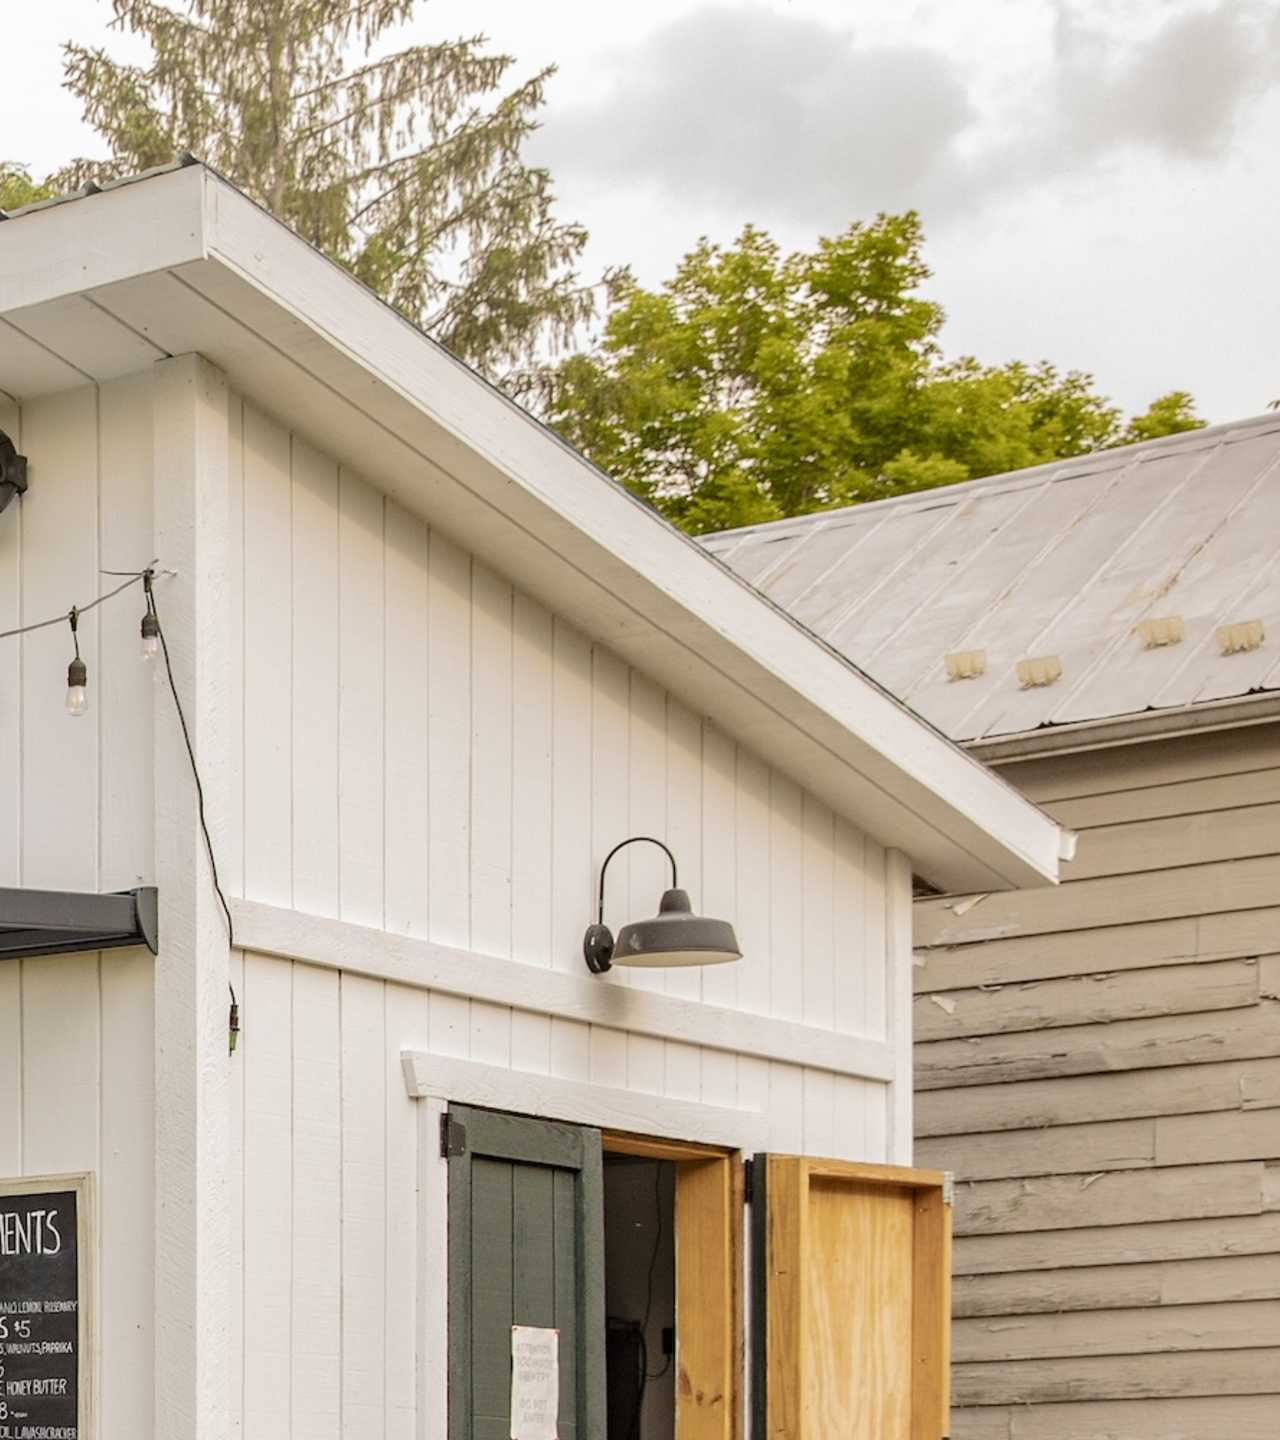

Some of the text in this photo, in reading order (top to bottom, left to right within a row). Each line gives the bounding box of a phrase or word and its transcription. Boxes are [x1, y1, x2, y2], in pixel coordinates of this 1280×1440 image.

[14, 1319, 31, 1338] $5
[7, 1380, 32, 1395] HONEY
[32, 1378, 68, 1395] BUTTER
